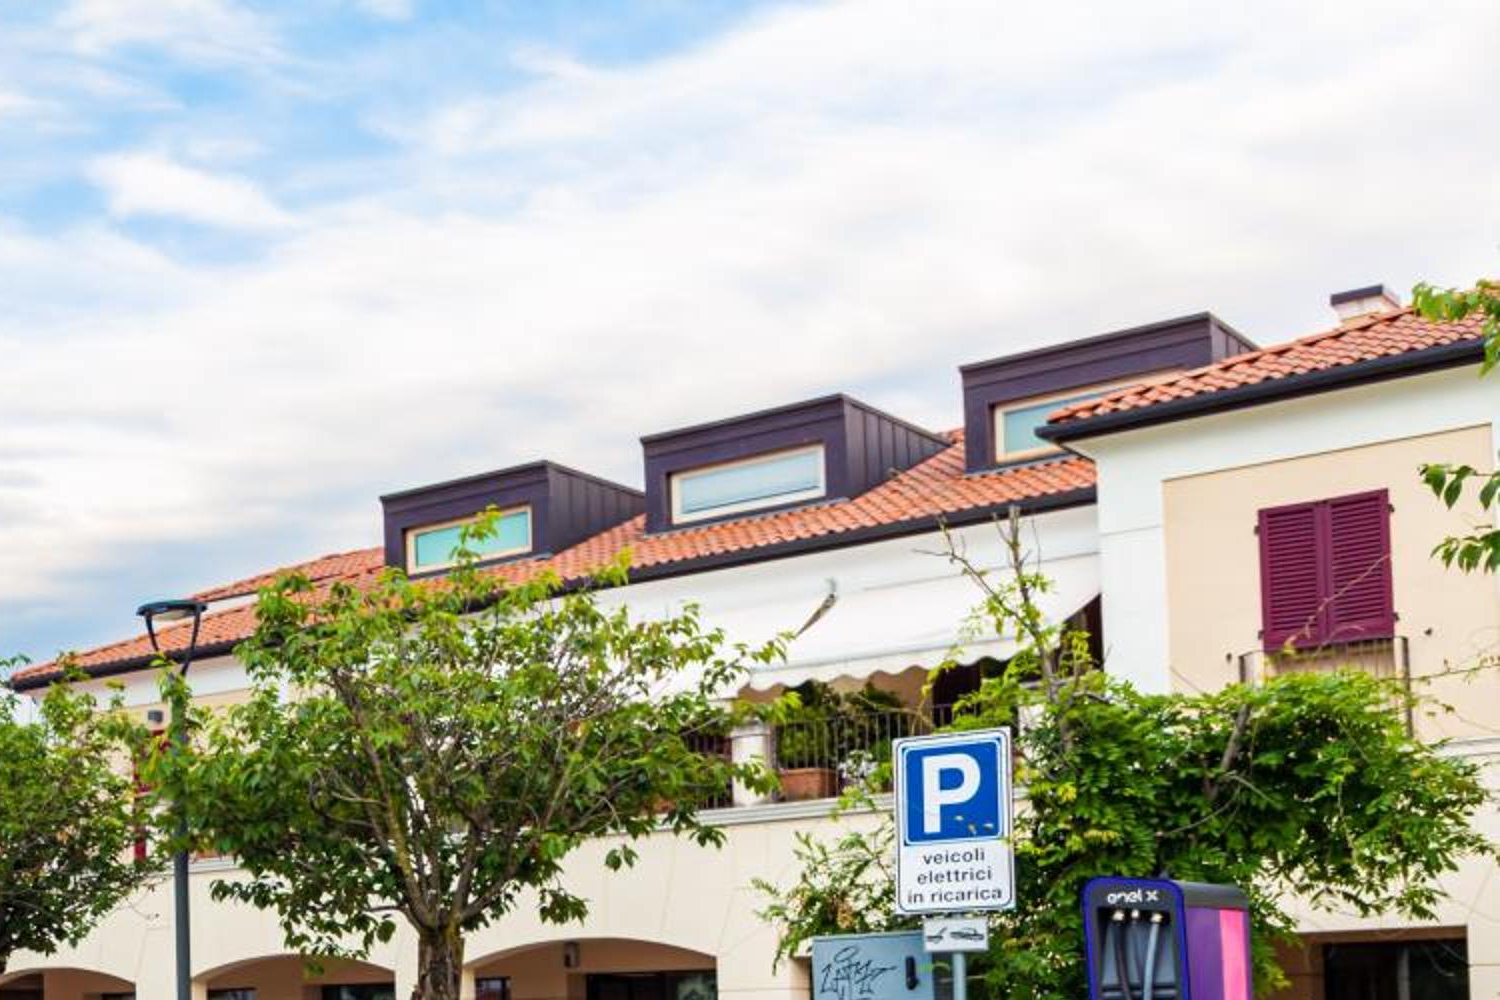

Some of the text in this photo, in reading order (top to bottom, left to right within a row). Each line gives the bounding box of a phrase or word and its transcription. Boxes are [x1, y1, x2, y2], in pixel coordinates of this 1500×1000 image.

[922, 753, 980, 833] P
[923, 848, 985, 864] veicoli
[917, 866, 992, 884] elettrici
[908, 887, 1002, 903] in ricarica
[1107, 888, 1143, 904] enel
